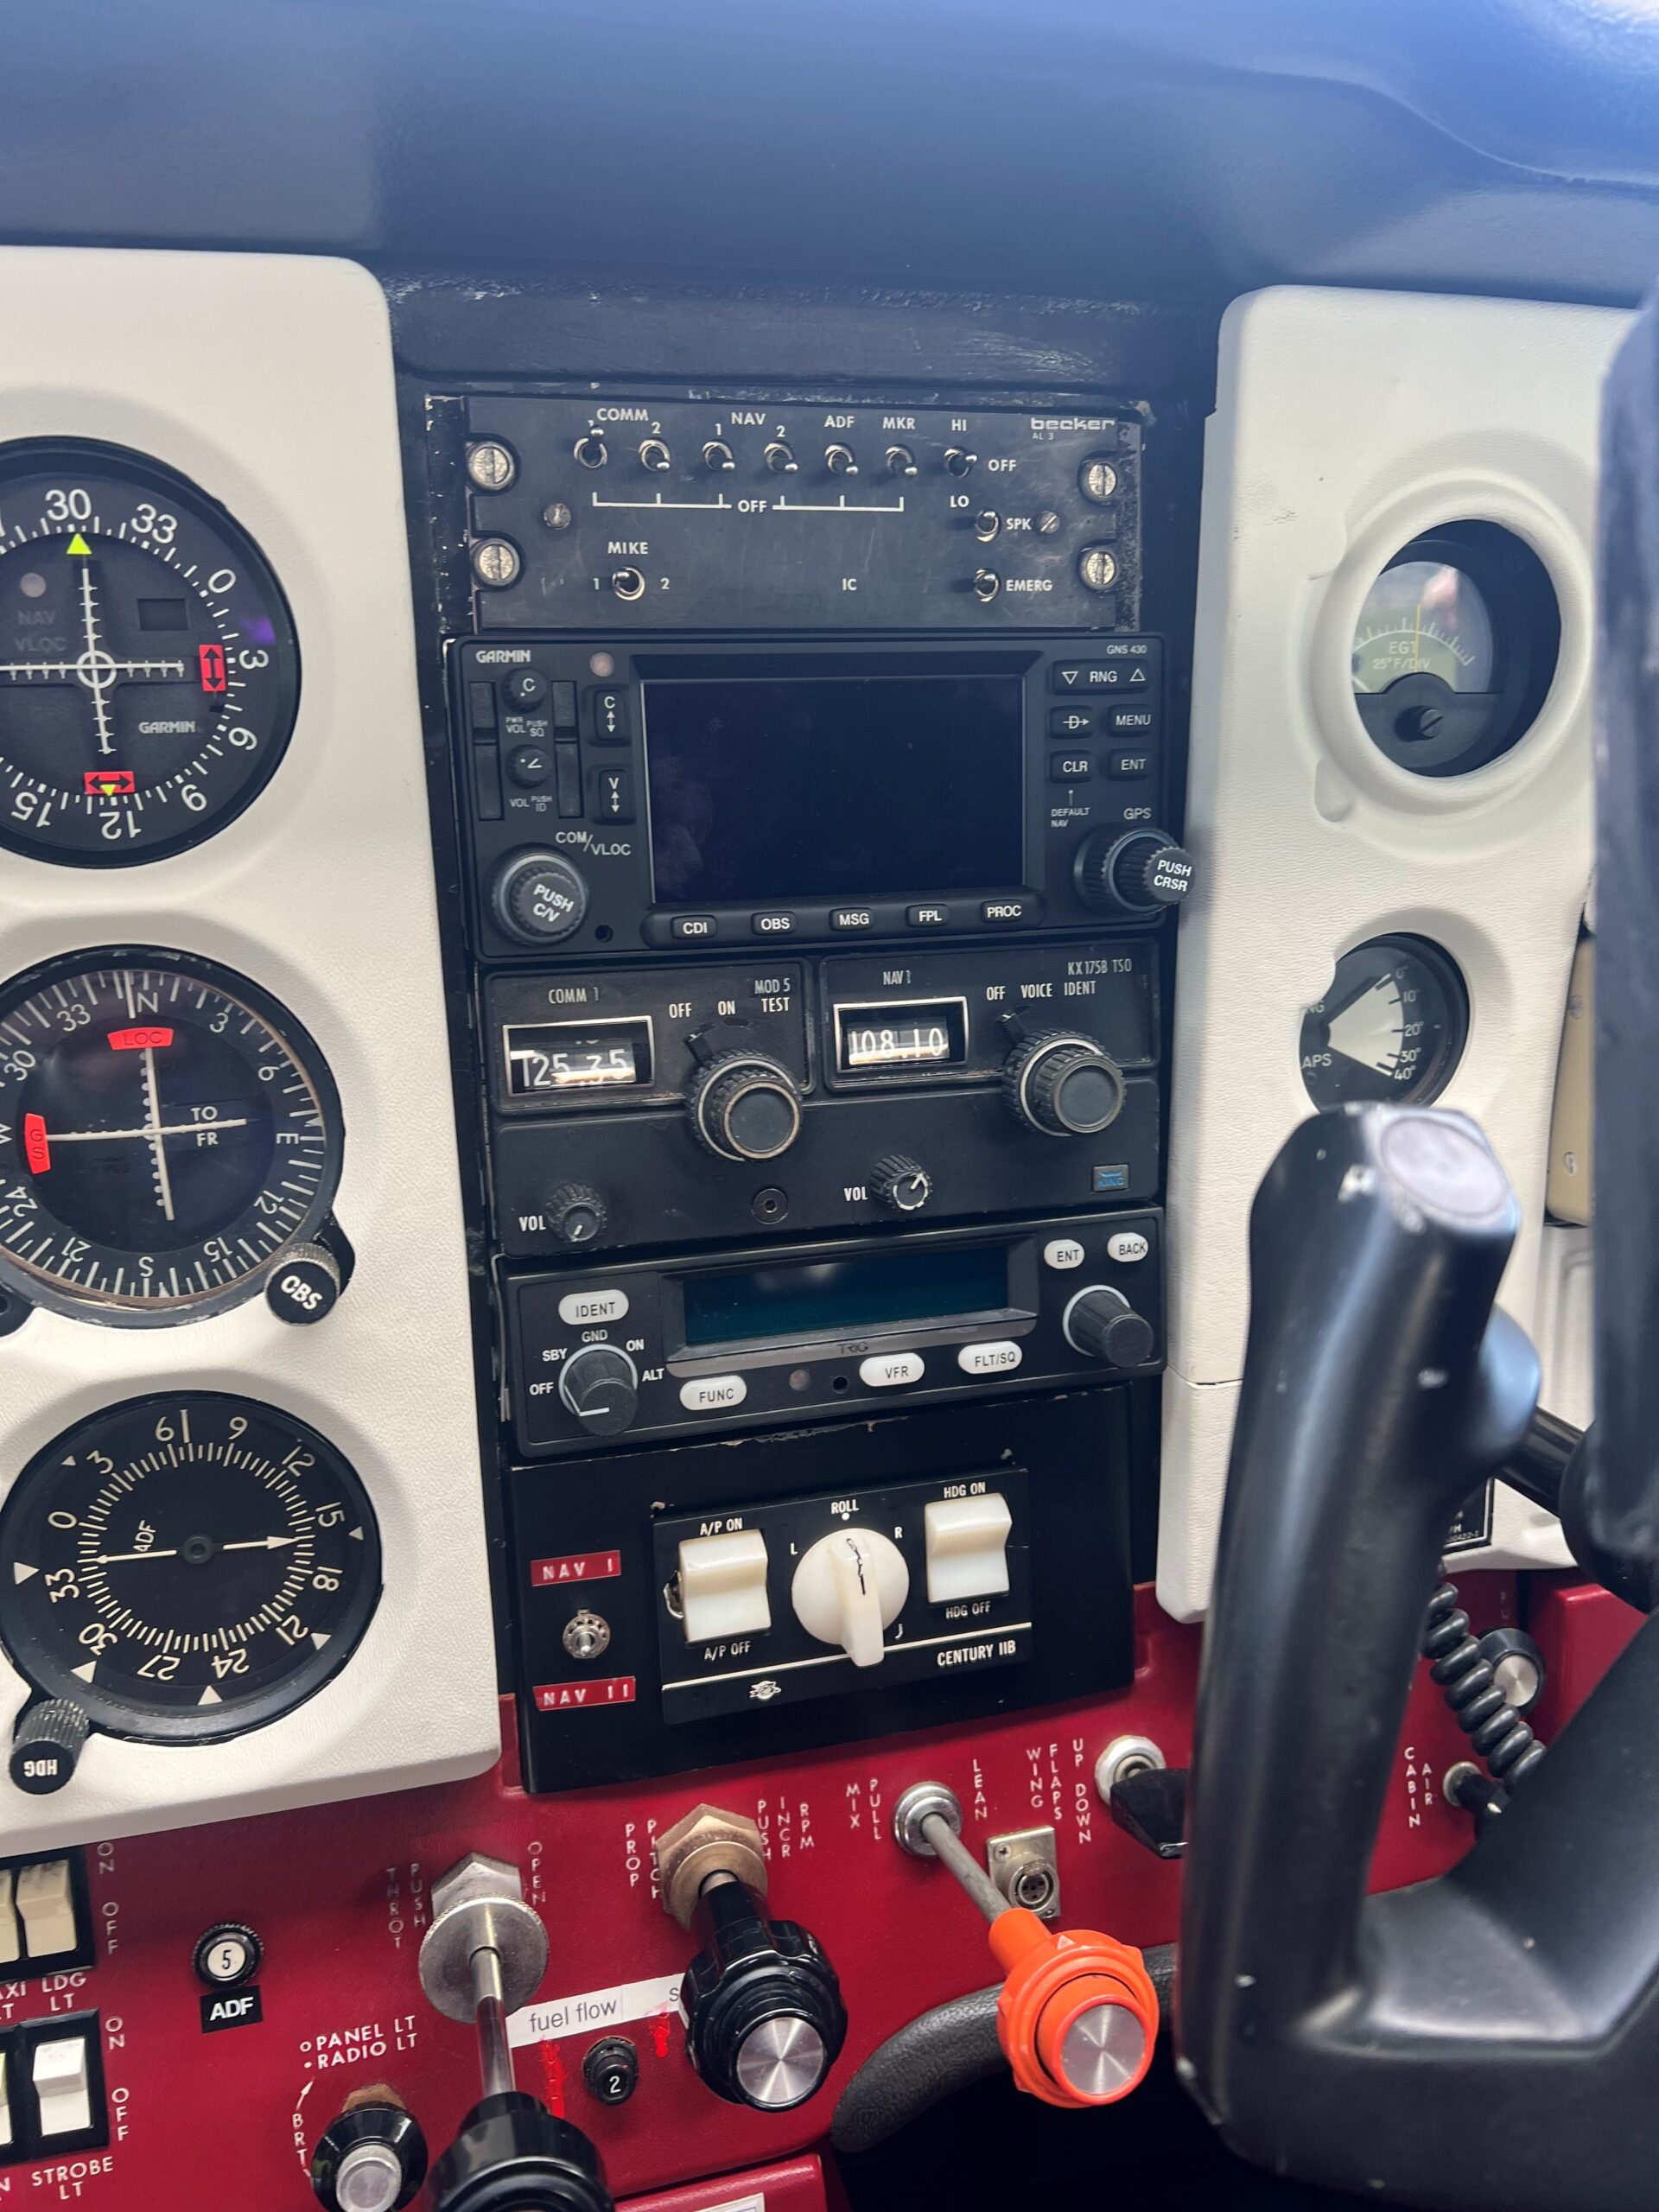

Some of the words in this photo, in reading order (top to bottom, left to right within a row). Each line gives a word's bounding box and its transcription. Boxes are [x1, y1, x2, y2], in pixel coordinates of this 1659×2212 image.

[596, 408, 649, 421] COMM
[731, 412, 766, 425] NAV
[824, 416, 855, 429] ADF
[882, 417, 916, 430] MKR
[1031, 417, 1116, 430] becker
[652, 422, 661, 434] 2
[776, 426, 785, 437] 2
[951, 419, 967, 431] HI
[988, 460, 1017, 472] OFF
[45, 489, 91, 519] 30
[738, 500, 767, 512] OFF
[950, 496, 969, 508] LO
[131, 504, 178, 543] 33
[1006, 518, 1032, 531] SPK
[607, 542, 649, 555] MIKE
[208, 569, 236, 594] 0
[660, 578, 671, 589] 2
[842, 578, 857, 591] IC
[1006, 580, 1053, 592] EMERG
[238, 650, 269, 670] 3
[476, 650, 531, 664] GARMIN
[1090, 671, 1118, 683] RNG
[138, 721, 196, 734] GARMIN
[1116, 715, 1151, 726] MENU
[229, 728, 258, 750] 6
[1063, 761, 1088, 772] CLR
[1122, 759, 1146, 771] ENT
[181, 785, 207, 811] 9
[11, 791, 52, 828] 15
[1051, 807, 1090, 817] DEFAULT
[1123, 808, 1152, 820] GPS
[99, 810, 142, 840] 12
[1157, 860, 1192, 878] PUSH
[1154, 874, 1188, 893] CRSR
[533, 883, 575, 912] PUSH
[532, 903, 561, 923] C/V
[839, 912, 870, 926] MSG
[918, 909, 942, 923] FPL
[987, 905, 1021, 918] PROC
[683, 922, 708, 935] CDI
[760, 917, 791, 931] OBS
[754, 979, 778, 995] MOD
[883, 971, 904, 985] NAV
[549, 988, 588, 1004] COMM
[986, 986, 1006, 1001] OFF
[1020, 983, 1052, 999] VOICE
[1064, 981, 1096, 996] IDENT
[137, 991, 159, 1014] N
[669, 1002, 692, 1019] OFF
[718, 1000, 735, 1016] ON
[761, 996, 790, 1013] TEST
[56, 1003, 92, 1033] 33
[208, 1012, 229, 1033] 3
[123, 1031, 163, 1046] LOC
[3, 1050, 36, 1081] 30
[191, 1107, 218, 1121] TO
[197, 1132, 219, 1147] FR
[276, 1132, 300, 1145] E
[4, 1185, 39, 1217] 24
[844, 1186, 868, 1202] VOL
[518, 1216, 546, 1231] VOL
[60, 1236, 92, 1263] 21
[203, 1236, 234, 1262] 15
[1057, 1249, 1079, 1262] ENT
[1118, 1241, 1147, 1255] BACK
[139, 1255, 154, 1279] S
[575, 1302, 616, 1319] IDENT
[582, 1329, 608, 1343] GND
[626, 1339, 645, 1352] ON
[542, 1348, 568, 1362] SBY
[975, 1351, 1016, 1368] FLT/SQ
[642, 1368, 664, 1382] ALT
[885, 1366, 908, 1379] VFR
[529, 1382, 554, 1396] OFF
[699, 1388, 734, 1403] FUNC
[155, 1416, 175, 1441] 6
[229, 1417, 248, 1440] 9
[87, 1450, 115, 1474] 3
[282, 1446, 315, 1477] 12
[944, 1484, 967, 1499] HDG
[970, 1481, 986, 1495] ON
[315, 1502, 345, 1527] 15
[831, 1499, 860, 1515] ROLL
[48, 1510, 78, 1529] 0
[700, 1520, 721, 1536] A/P
[727, 1517, 743, 1531] ON
[133, 1520, 156, 1552] ADF
[894, 1526, 903, 1539] R
[313, 1567, 343, 1592] 18
[543, 1561, 585, 1580] NAV
[44, 1568, 80, 1604] 33
[945, 1605, 968, 1619] HDG
[971, 1601, 991, 1615] OFF
[276, 1614, 309, 1645] 21
[79, 1622, 118, 1656] 30
[704, 1644, 727, 1661] A/P
[731, 1641, 751, 1655] OFF
[937, 1643, 993, 1668] CENTURY
[137, 1654, 181, 1681] 27
[212, 1649, 251, 1680] 24
[543, 1689, 587, 1707] NAV
[23, 1759, 58, 1777] HDG
[973, 1758, 988, 1821] LEAN
[1027, 1747, 1043, 1808] WING
[1049, 1744, 1063, 1821] FLAPS
[1404, 1746, 1421, 1828] CABIN
[1421, 1763, 1433, 1806] AIR
[846, 1783, 861, 1829] MIX
[869, 1778, 882, 1841] PULL
[1075, 1783, 1091, 1844] DOWN
[800, 1803, 815, 1849] RPM
[97, 1842, 115, 1874] ON
[626, 1823, 640, 1887] PROP
[527, 1841, 546, 1906] OPEN
[410, 1863, 426, 1928] PUSH
[102, 1902, 119, 1955] OFF
[222, 1950, 231, 1969] 5
[41, 1972, 86, 1993] LDG
[50, 1993, 74, 2012] LT
[209, 1997, 254, 2022] ADF
[530, 2006, 569, 2033] fuel
[575, 1998, 618, 2024] flow
[105, 2017, 125, 2050] ON
[316, 2023, 384, 2051] PANEL
[394, 2015, 416, 2033] LT
[317, 2041, 387, 2069] RADIO
[397, 2032, 417, 2050] LT
[609, 2075, 622, 2094] 2
[111, 2088, 130, 2142] OFF
[292, 2113, 308, 2168] BRT
[31, 2156, 113, 2187] STROBE
[59, 2181, 84, 2200] LT
